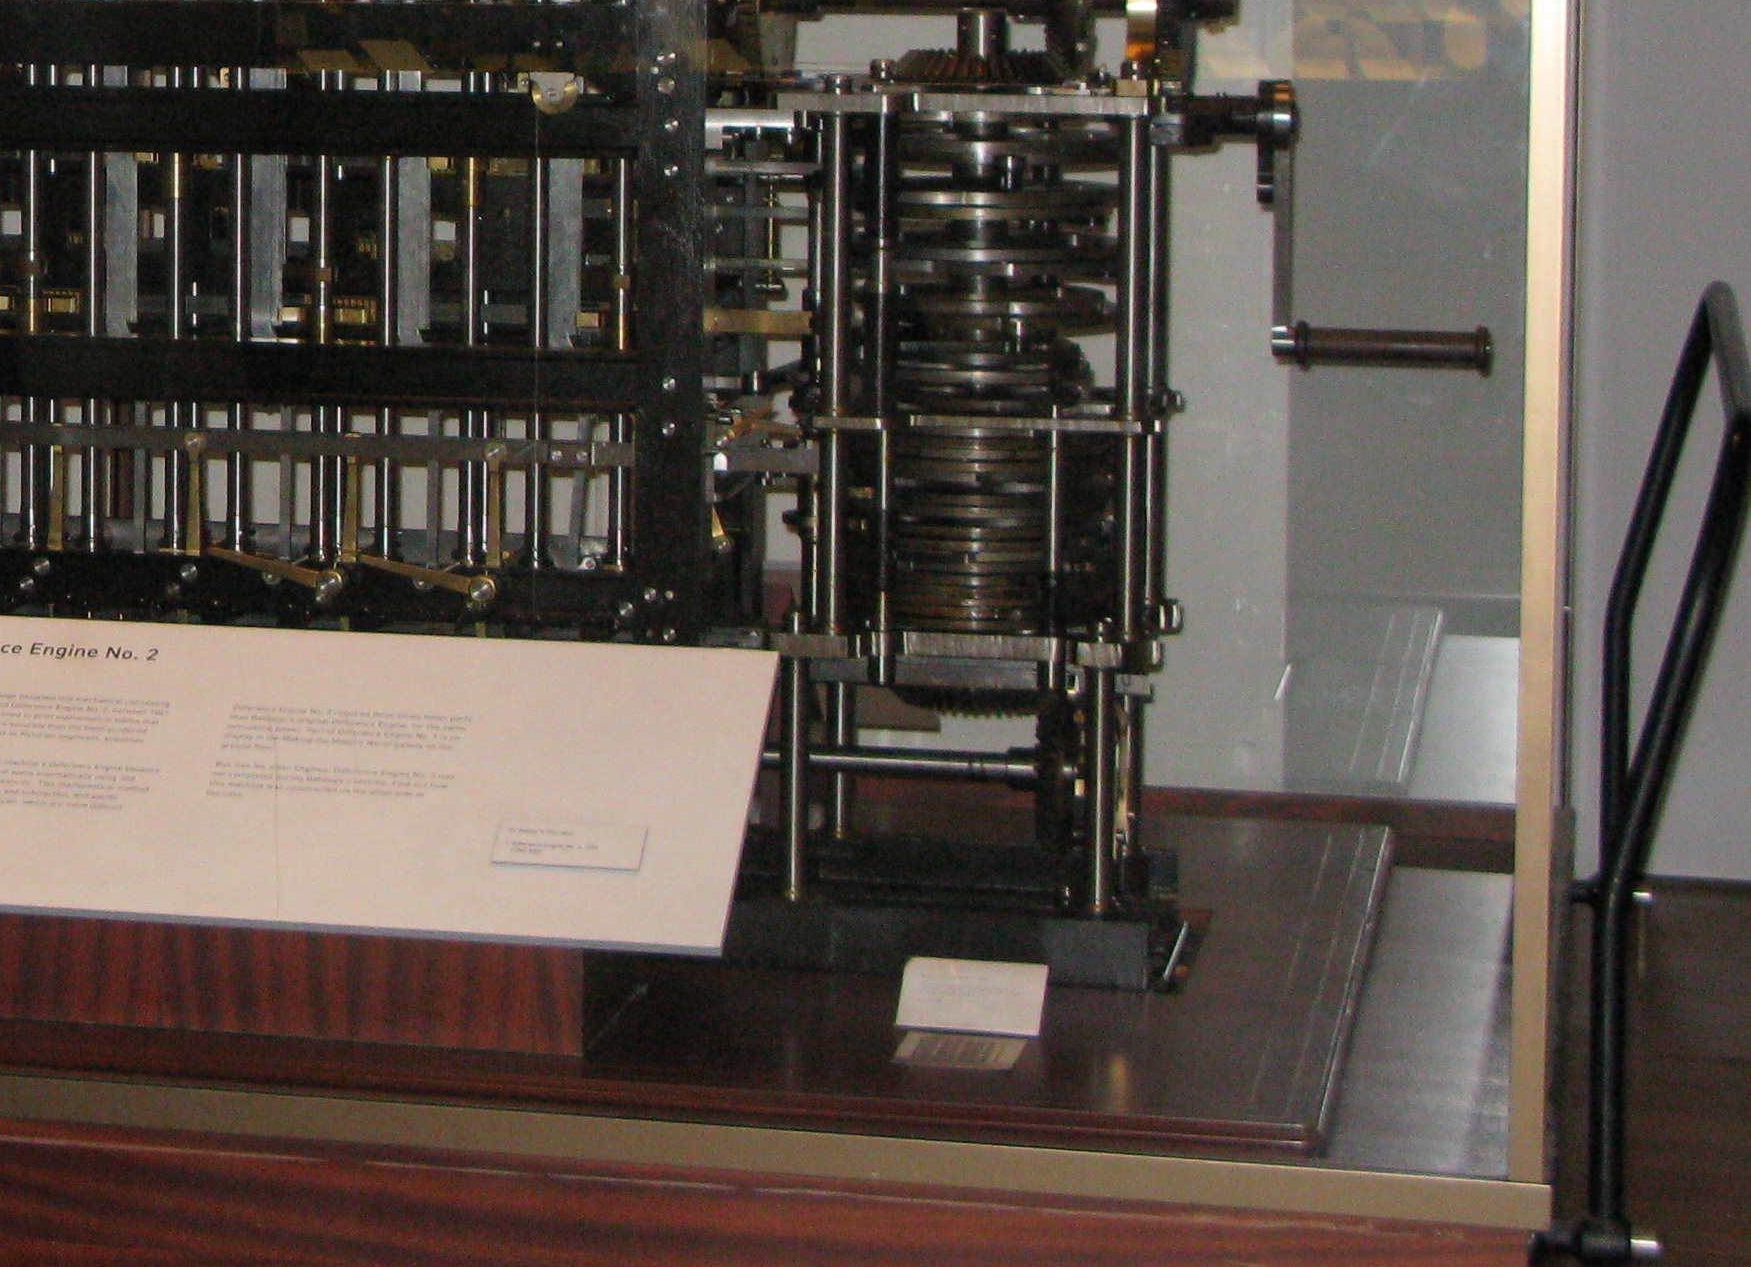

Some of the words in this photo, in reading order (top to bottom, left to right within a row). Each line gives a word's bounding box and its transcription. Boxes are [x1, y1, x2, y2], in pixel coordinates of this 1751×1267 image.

[29, 642, 99, 660] Engine
[105, 646, 139, 661] No.
[146, 648, 160, 662] 2
